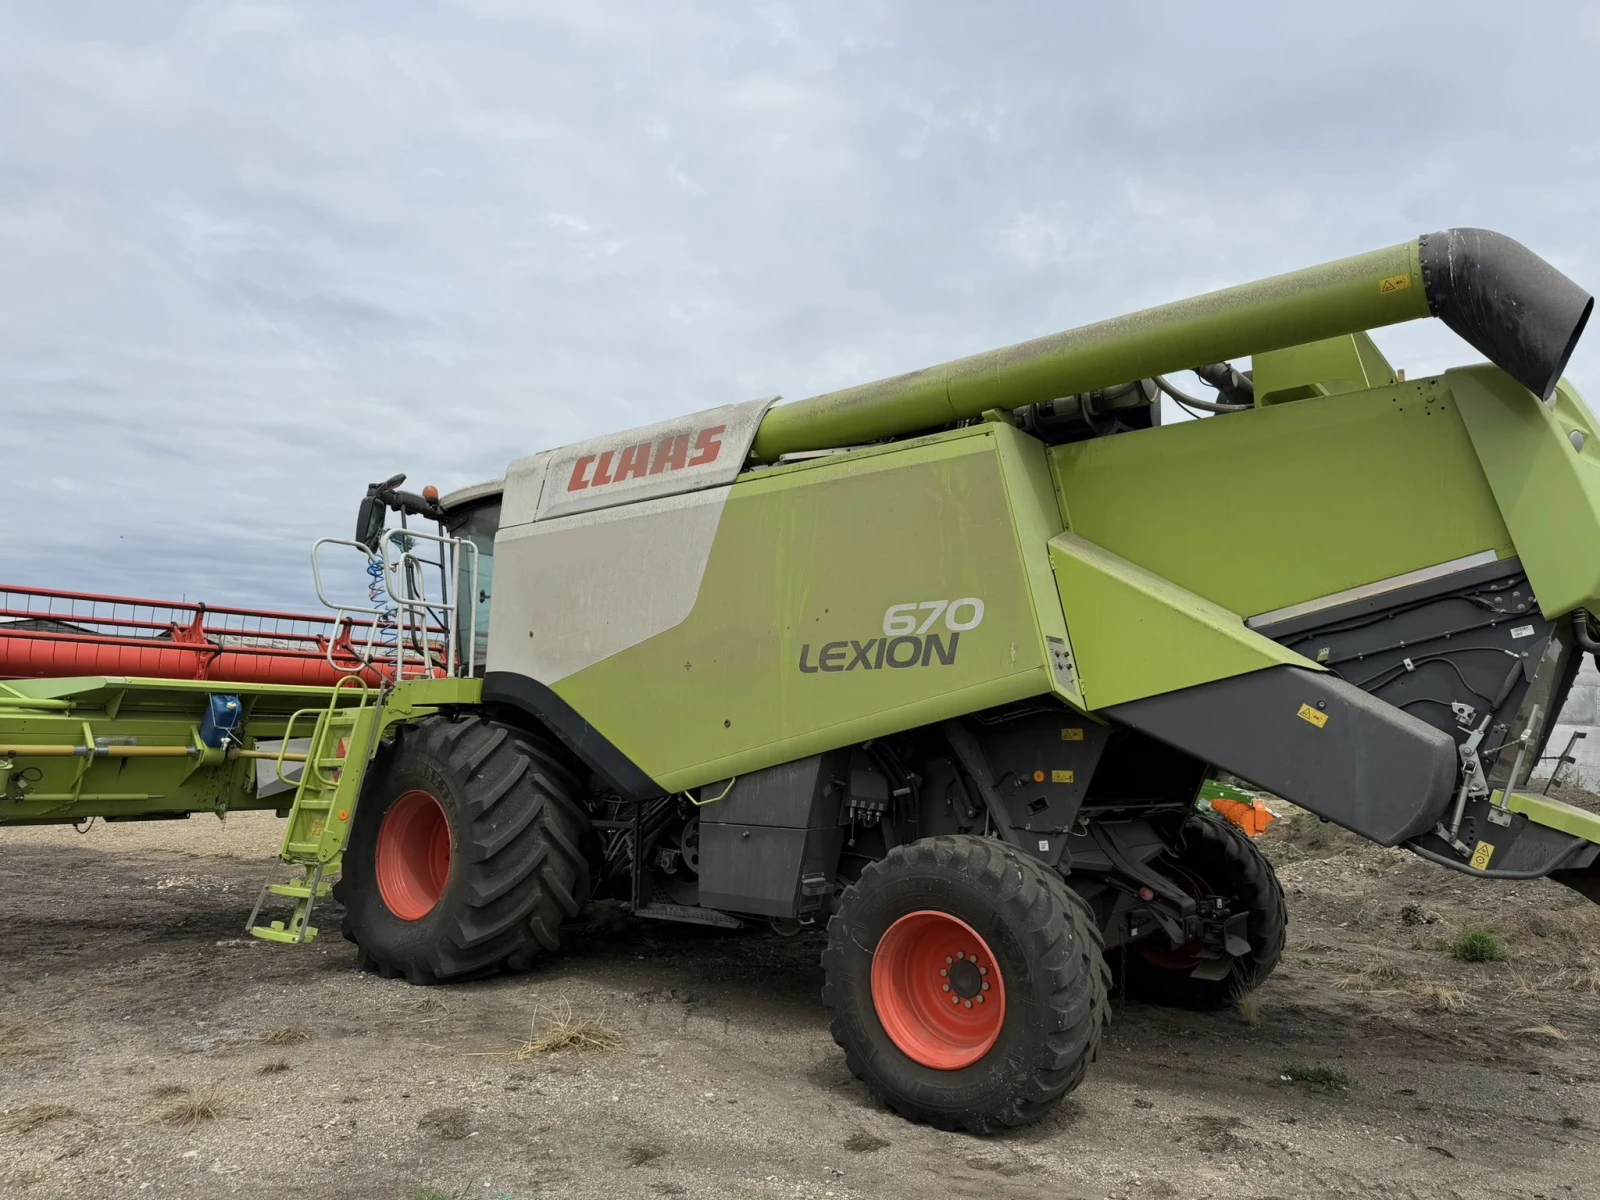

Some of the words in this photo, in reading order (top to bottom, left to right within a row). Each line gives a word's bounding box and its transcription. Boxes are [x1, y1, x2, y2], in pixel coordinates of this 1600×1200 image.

[567, 424, 727, 491] CLAAS
[882, 597, 985, 637] 670
[798, 632, 960, 674] LEXION
